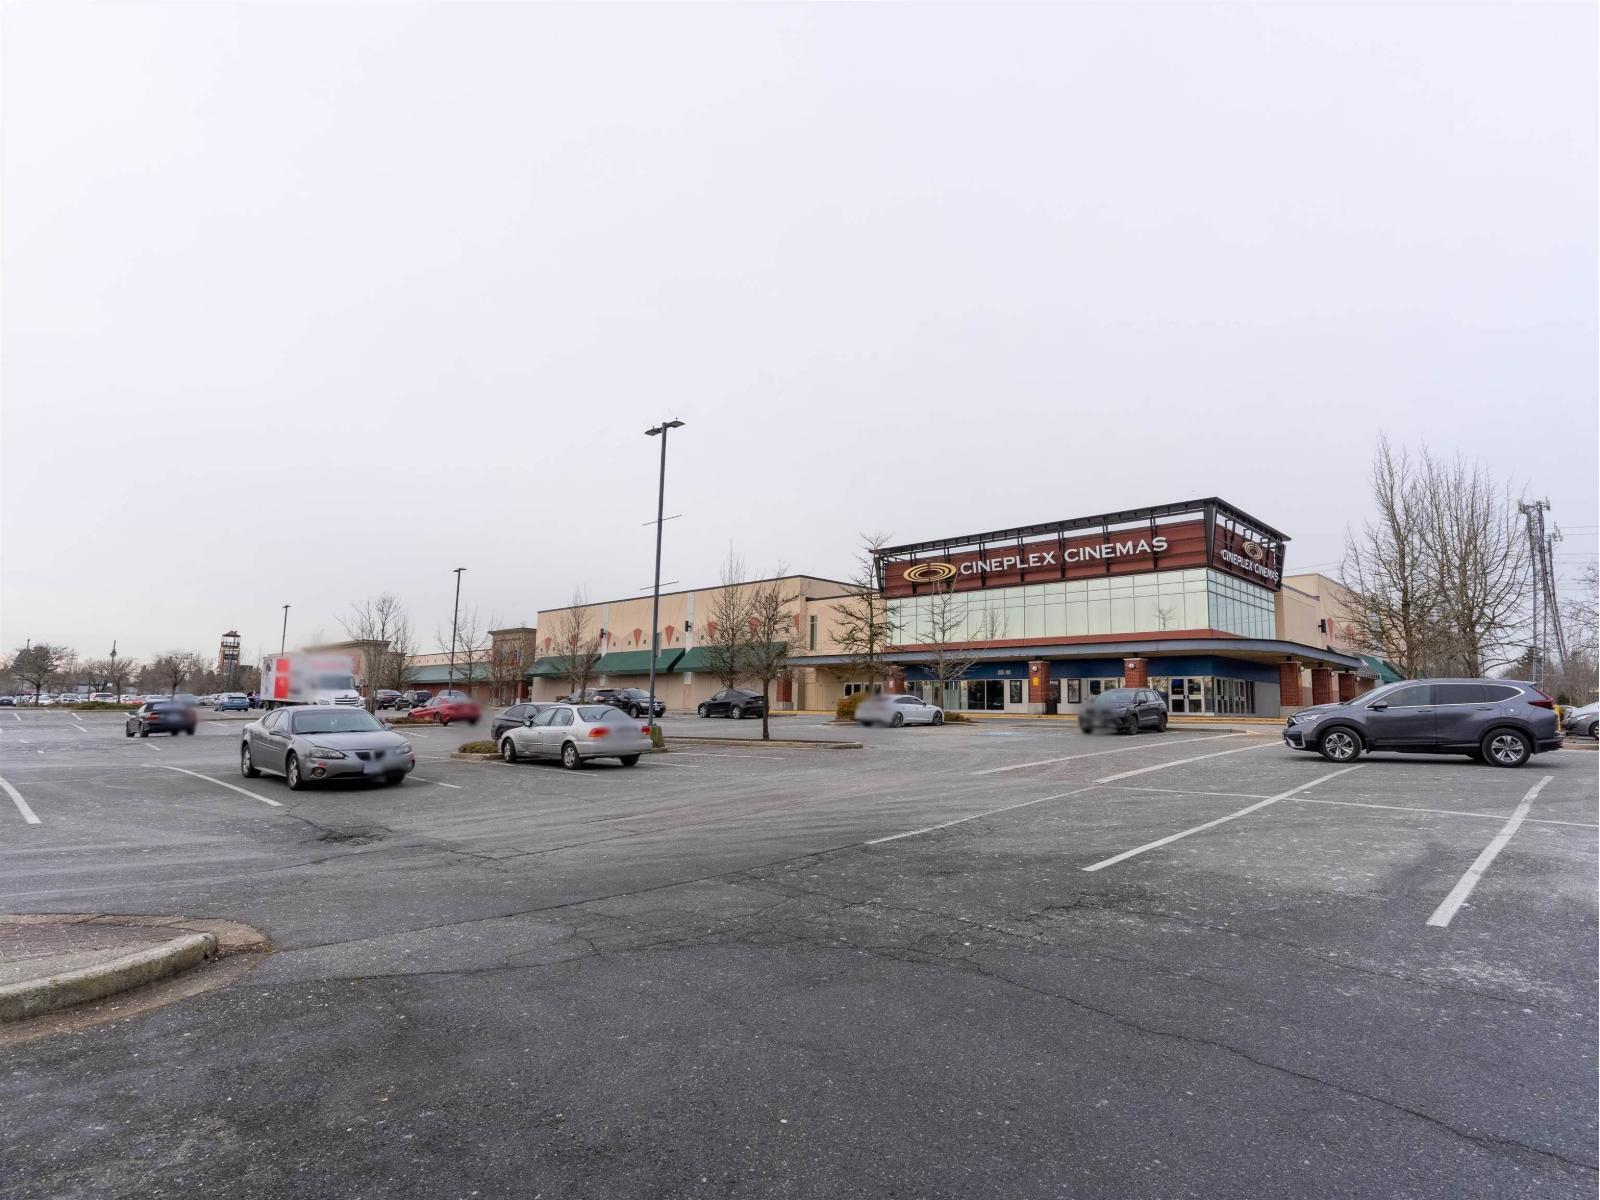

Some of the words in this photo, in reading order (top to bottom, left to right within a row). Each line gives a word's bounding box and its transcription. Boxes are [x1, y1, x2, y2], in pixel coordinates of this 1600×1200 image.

[960, 551, 1056, 575] CINEPLEX
[1064, 536, 1168, 564] CINEMAS
[1221, 549, 1253, 571] CINEPLEX
[1254, 563, 1279, 582] CINEMAS
